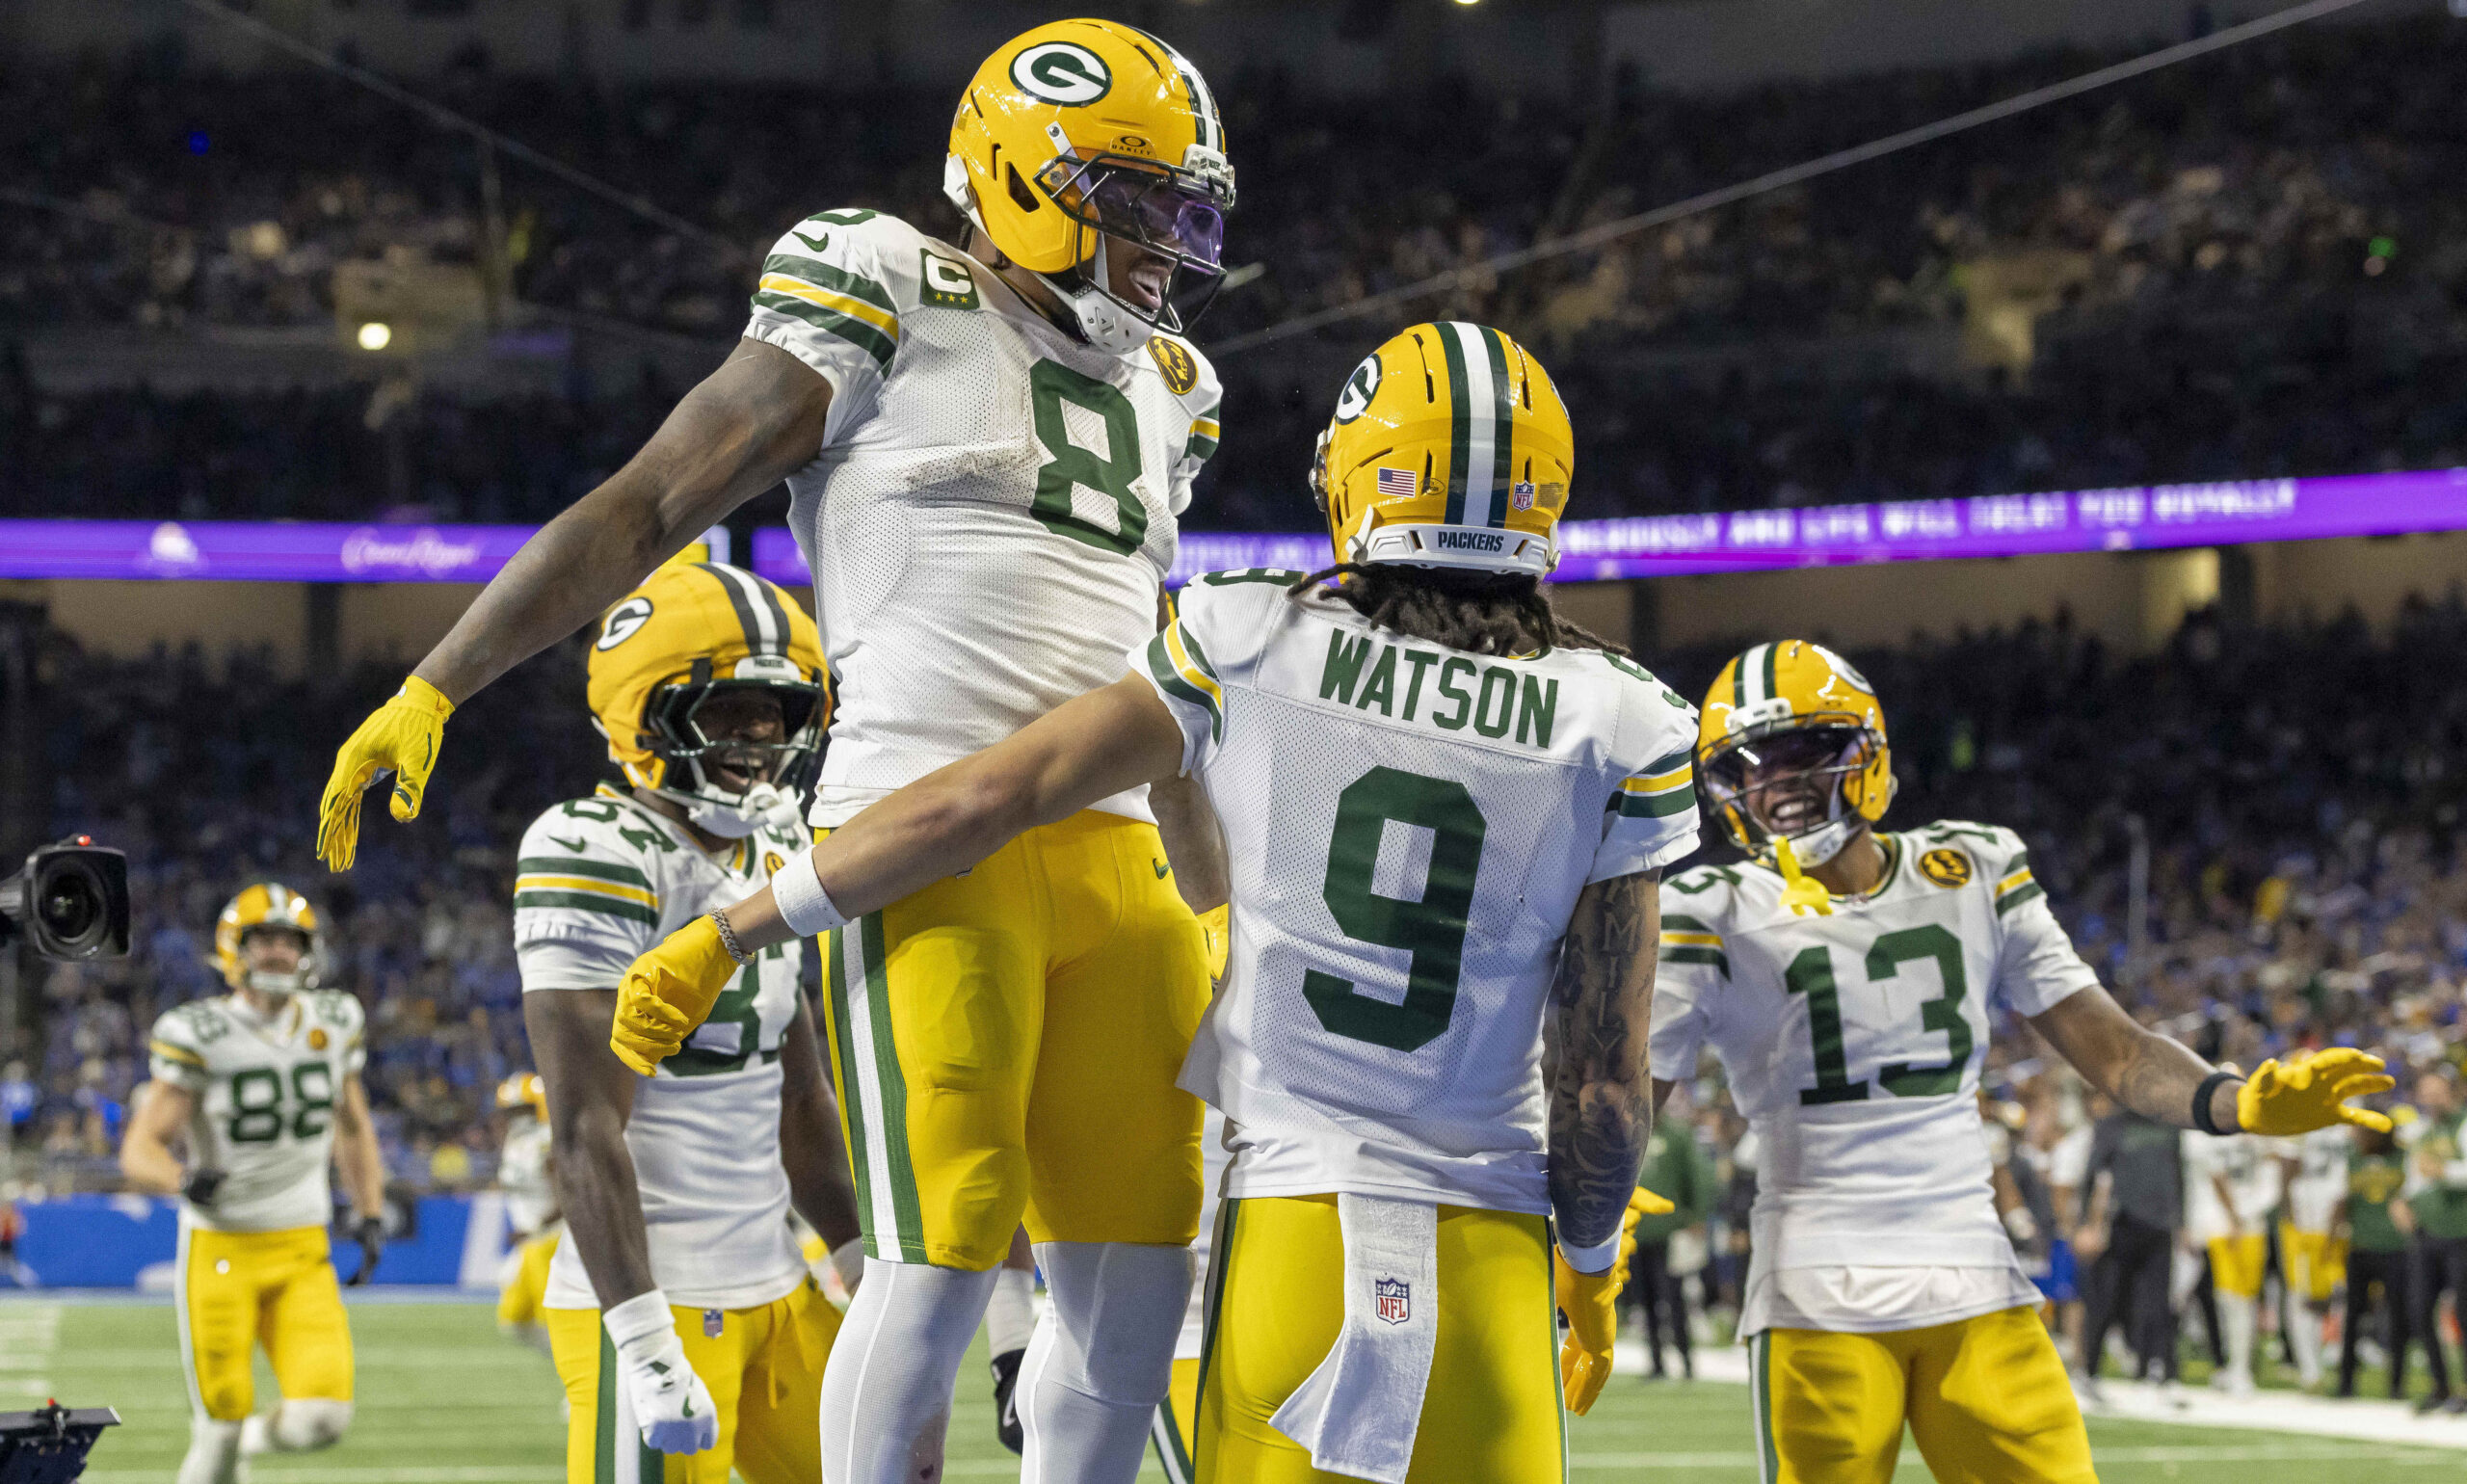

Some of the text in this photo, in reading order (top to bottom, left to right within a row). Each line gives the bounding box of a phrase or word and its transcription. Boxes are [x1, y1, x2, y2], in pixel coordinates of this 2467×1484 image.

[1012, 42, 1108, 103] G
[1111, 144, 1152, 156] OAKLEY
[925, 253, 972, 295] C
[1336, 355, 1379, 421] G
[1030, 358, 1150, 557] 8
[1515, 493, 1530, 507] NFL
[1437, 530, 1505, 553] PACKERS
[597, 596, 653, 651] G
[1318, 628, 1559, 749] WATSON
[1303, 765, 1487, 1053] 9
[1785, 923, 1974, 1106] 13
[230, 1062, 333, 1143] 88
[1379, 1296, 1407, 1320] NFL
